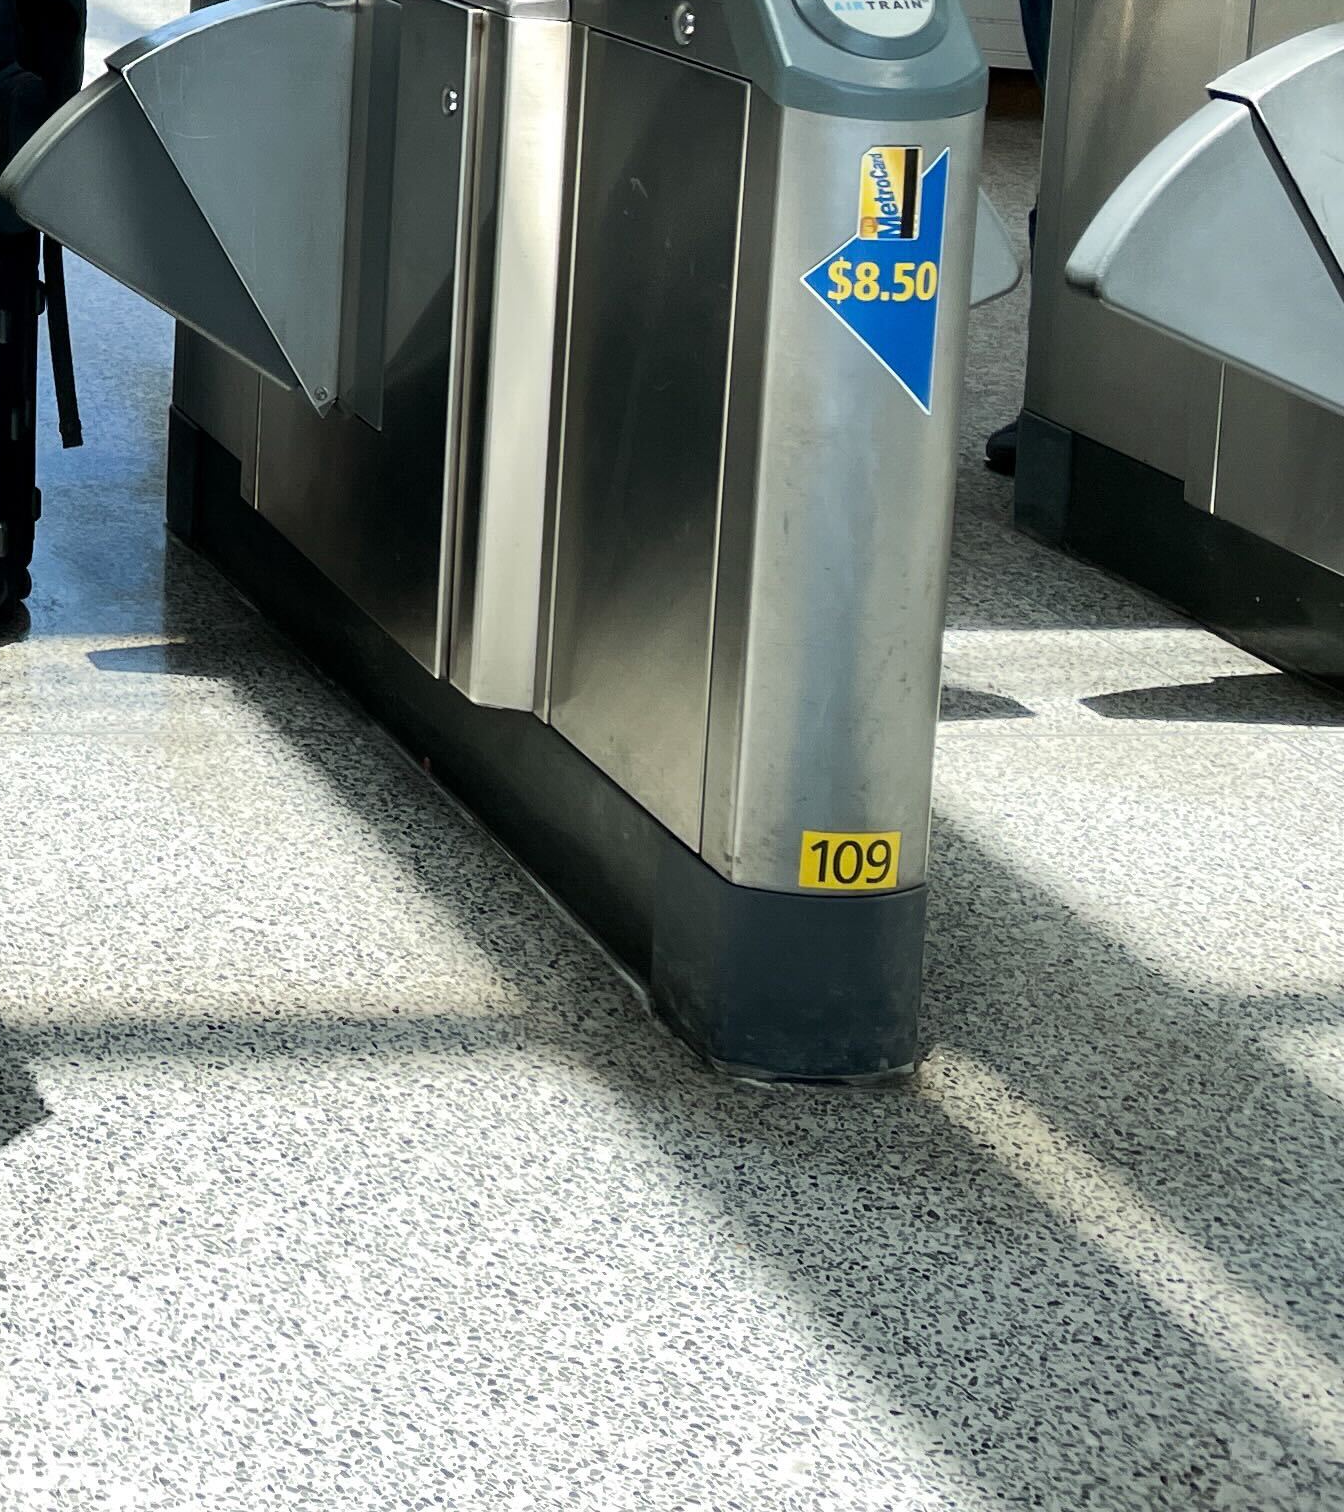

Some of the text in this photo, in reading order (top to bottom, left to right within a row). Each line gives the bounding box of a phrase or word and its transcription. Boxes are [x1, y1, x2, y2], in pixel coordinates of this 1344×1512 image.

[869, 152, 902, 238] MetroCard
[827, 256, 938, 305] $8.50
[810, 839, 892, 884] 109
